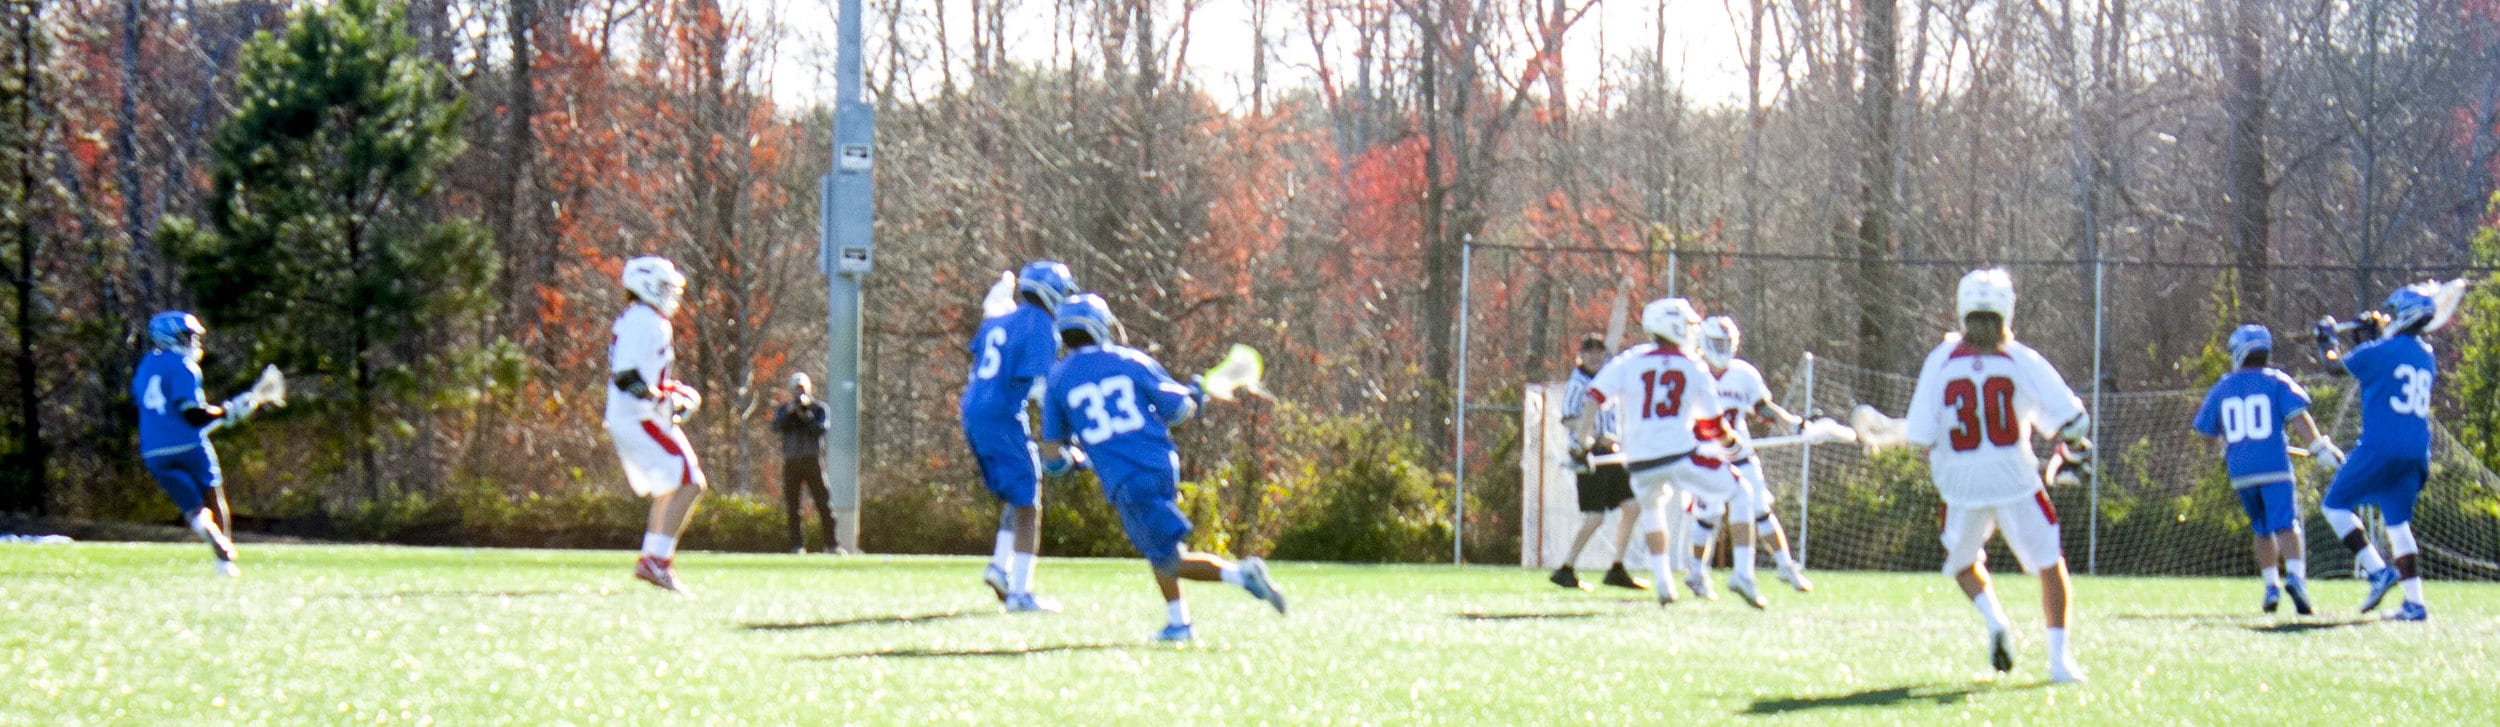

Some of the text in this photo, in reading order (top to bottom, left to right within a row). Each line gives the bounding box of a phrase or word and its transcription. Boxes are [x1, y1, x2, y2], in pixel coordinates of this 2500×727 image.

[143, 374, 167, 416] 4
[1067, 374, 1145, 445] 33
[1642, 369, 1686, 419] 13
[1944, 376, 2020, 453] 30
[2389, 363, 2433, 419] 38
[2221, 393, 2272, 443] 00
